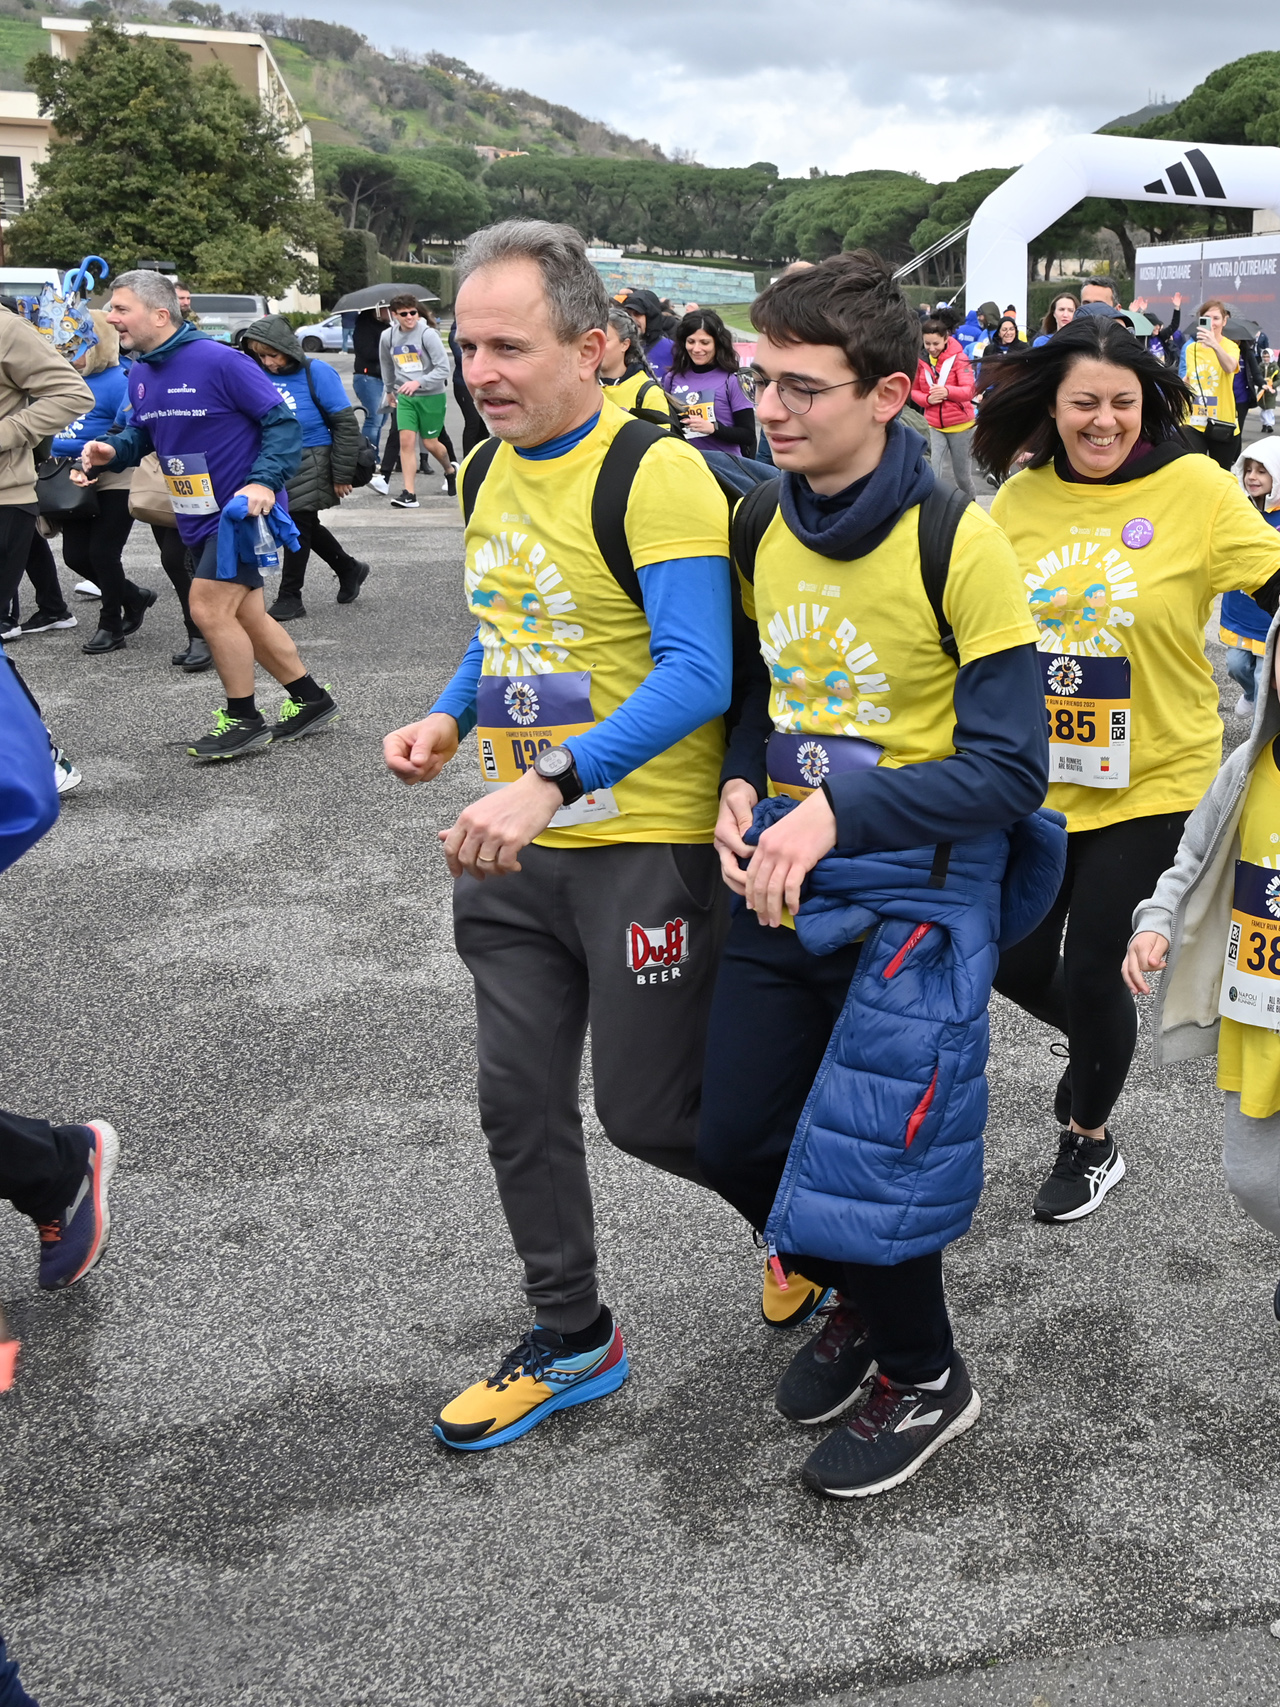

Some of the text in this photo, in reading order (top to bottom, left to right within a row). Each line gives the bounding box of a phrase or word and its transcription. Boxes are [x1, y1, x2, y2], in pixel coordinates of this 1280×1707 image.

[1139, 265, 1156, 280] MOSTRA
[1208, 261, 1233, 278] MOSTRA
[167, 383, 197, 394] accenture
[173, 480, 194, 495] 429
[1095, 548, 1138, 601] RUN
[524, 542, 577, 616] RUN
[552, 620, 584, 644] &
[1106, 606, 1135, 628] &
[829, 617, 891, 694] RUN
[1047, 656, 1070, 676] FAMILY
[1069, 659, 1083, 677] RUN
[504, 682, 523, 705] FAMILY
[523, 684, 539, 703] RUN
[1047, 678, 1079, 696] FRIENDS
[507, 708, 539, 725] FRIENDS
[855, 701, 891, 725] &
[797, 741, 816, 764] FAMILY
[816, 744, 829, 764] RUN
[1066, 757, 1082, 766] RUNNERS
[1066, 764, 1083, 772] BEAUTIFUL
[1251, 919, 1266, 930] FAMILY
[1266, 923, 1278, 931] RUN
[631, 918, 684, 971] Duff
[636, 967, 681, 985] BEER
[1238, 991, 1258, 1001] NAPOLI
[1238, 998, 1257, 1007] RUNNING
[1268, 996, 1276, 1004] ALL
[1267, 1003, 1275, 1012] ARE
